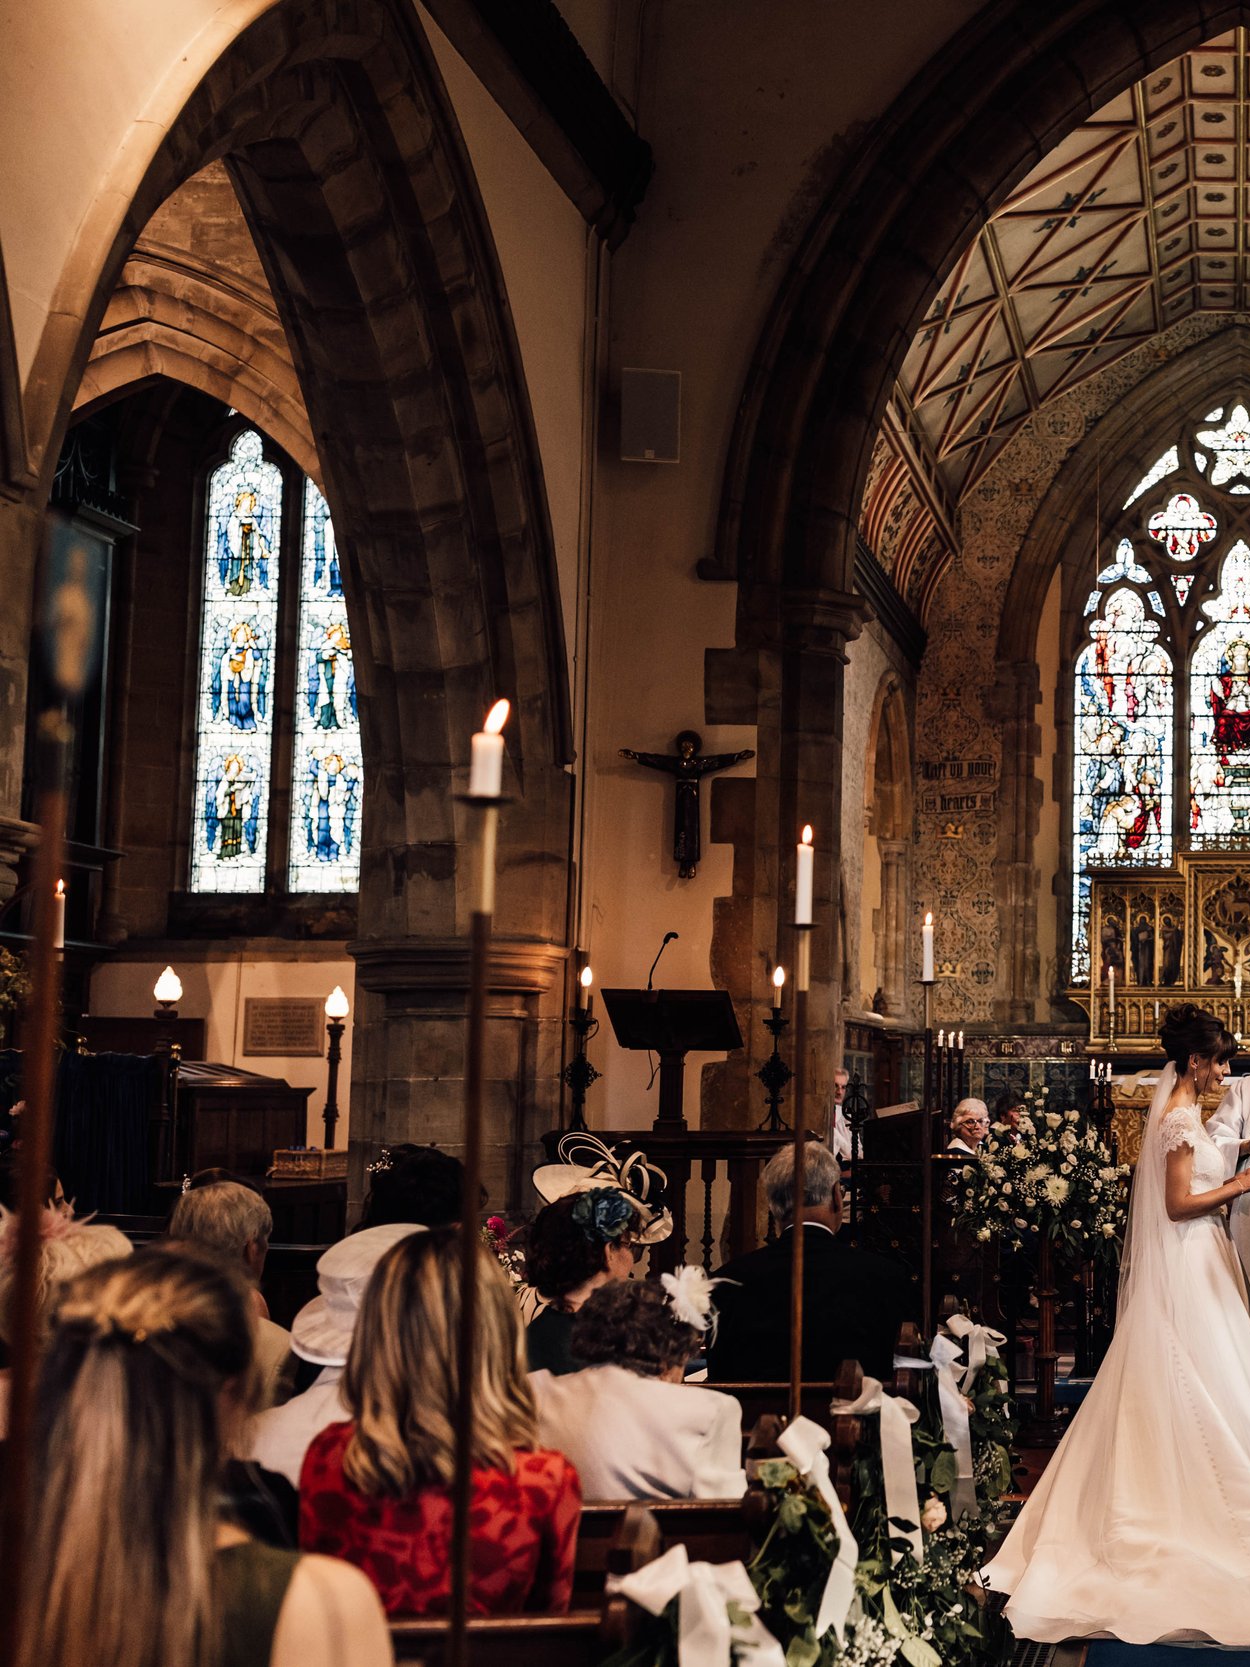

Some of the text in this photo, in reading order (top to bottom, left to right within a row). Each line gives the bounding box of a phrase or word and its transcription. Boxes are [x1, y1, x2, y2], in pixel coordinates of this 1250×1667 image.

[950, 762, 963, 778] up
[967, 762, 993, 778] your
[940, 794, 977, 811] hearts
